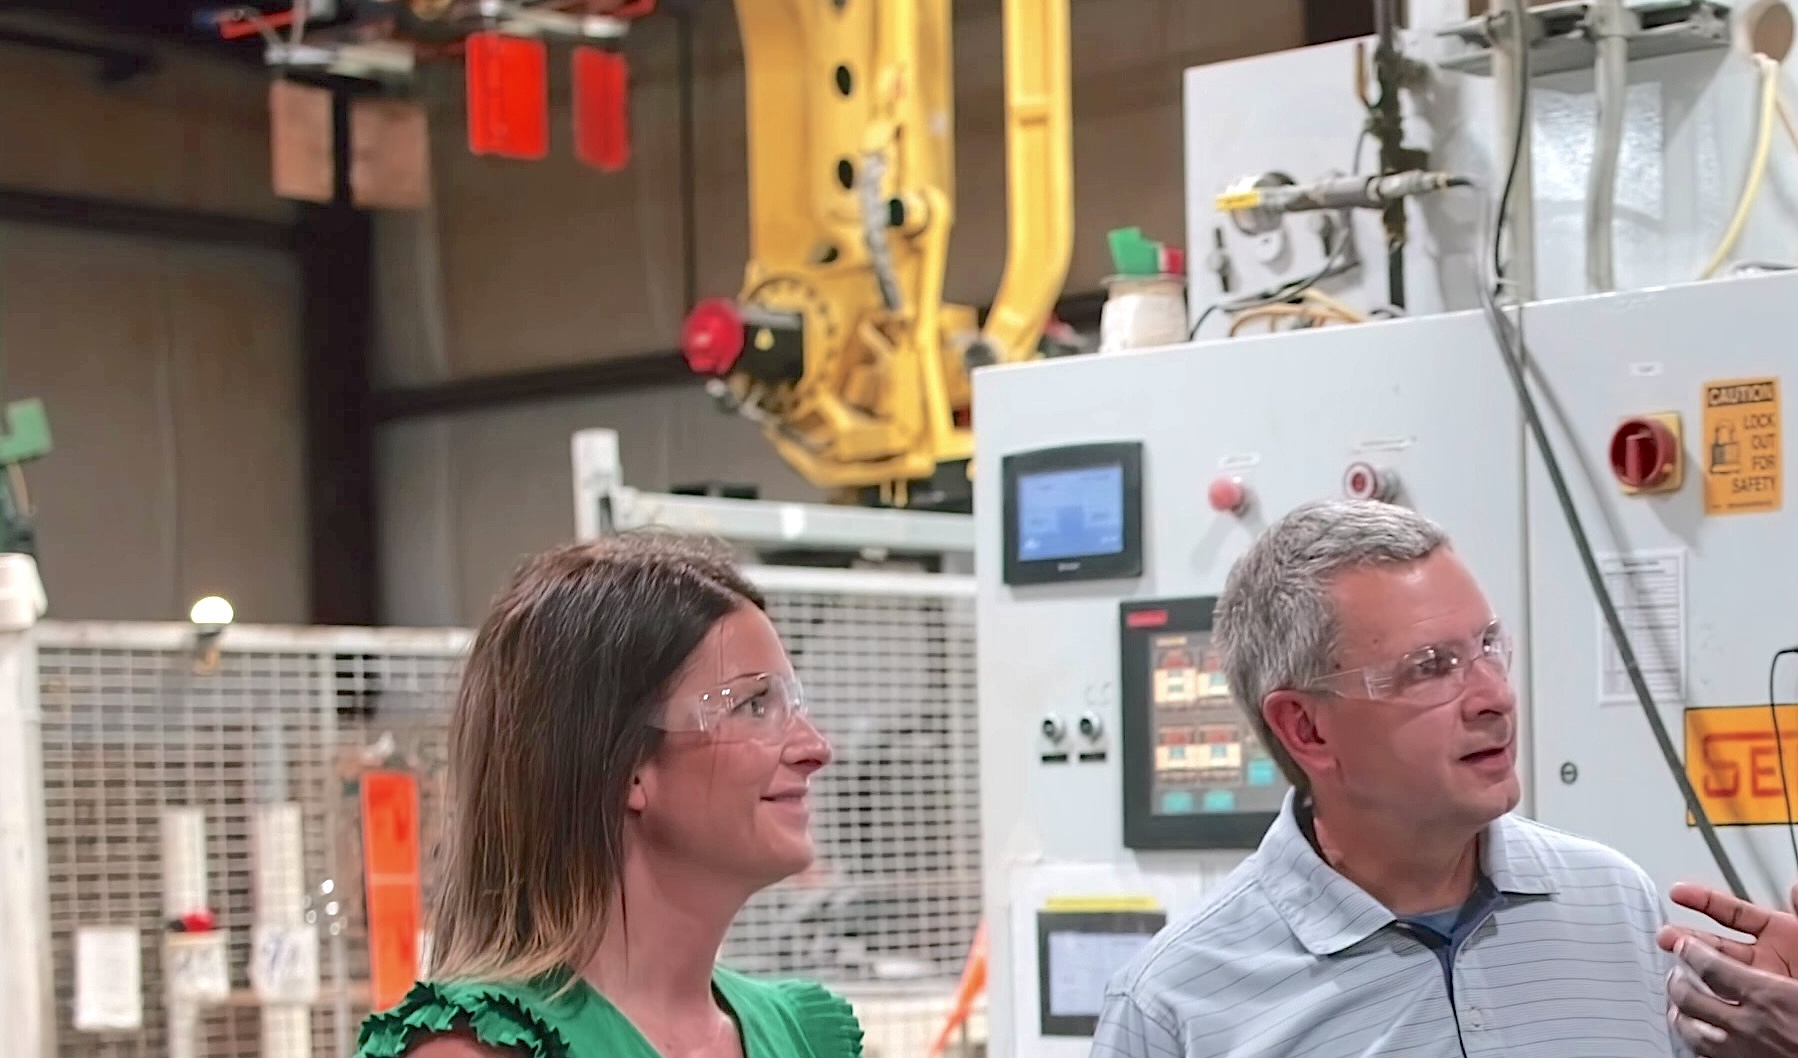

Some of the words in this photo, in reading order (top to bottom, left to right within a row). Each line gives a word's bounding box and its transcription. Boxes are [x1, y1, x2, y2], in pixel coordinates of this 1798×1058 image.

[1707, 384, 1774, 406] CAUTION
[1743, 413, 1776, 430] LOCK
[1751, 432, 1776, 450] OUT
[1751, 454, 1776, 471] FOR
[1731, 475, 1775, 494] SAFETY
